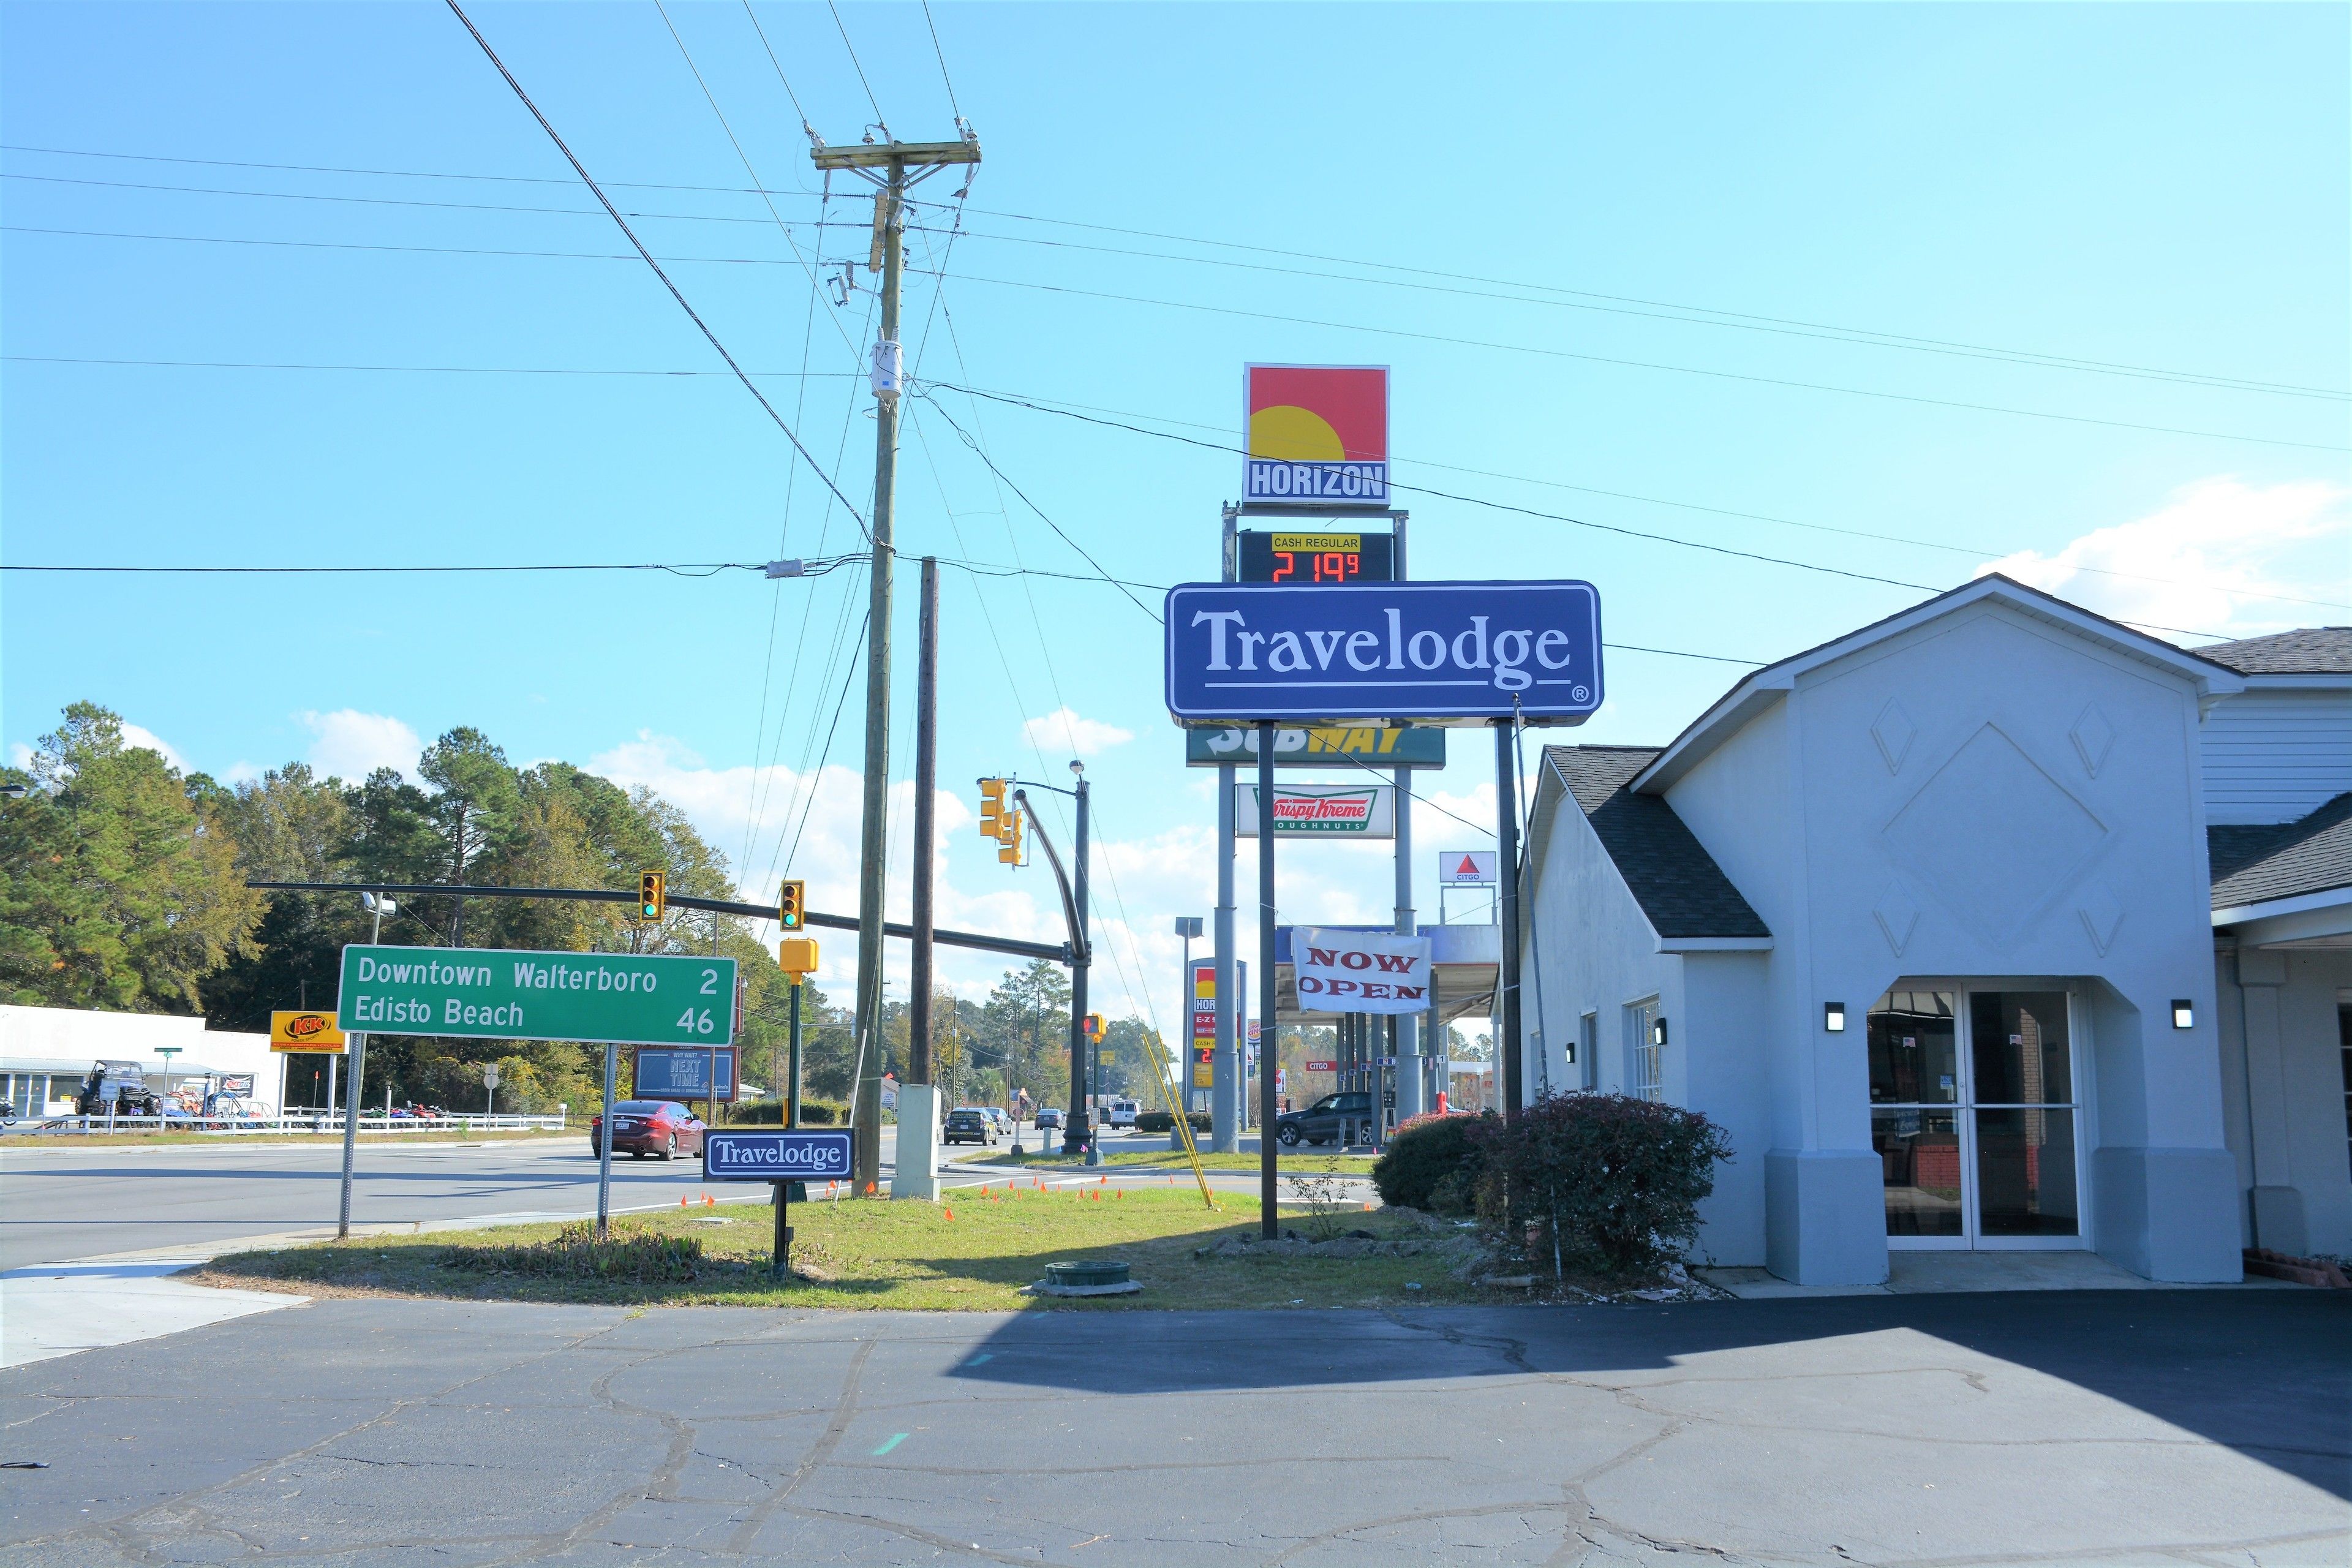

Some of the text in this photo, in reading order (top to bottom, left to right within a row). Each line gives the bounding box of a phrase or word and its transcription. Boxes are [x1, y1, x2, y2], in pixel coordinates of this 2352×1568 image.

[1251, 464, 1382, 496] HORIZON
[1275, 538, 1358, 548] CASH REGULAR
[1191, 608, 1570, 690] Travelodge
[1315, 799, 1368, 818] Kreme
[1305, 947, 1419, 974] NOW
[358, 957, 718, 995] Downtown Walterboro 2
[1298, 976, 1427, 1000] OPEN
[355, 995, 715, 1035] Edisto Beach 46
[670, 1059, 701, 1073] NEXT
[670, 1073, 699, 1087] TIME
[716, 1140, 840, 1170] Travelodge
